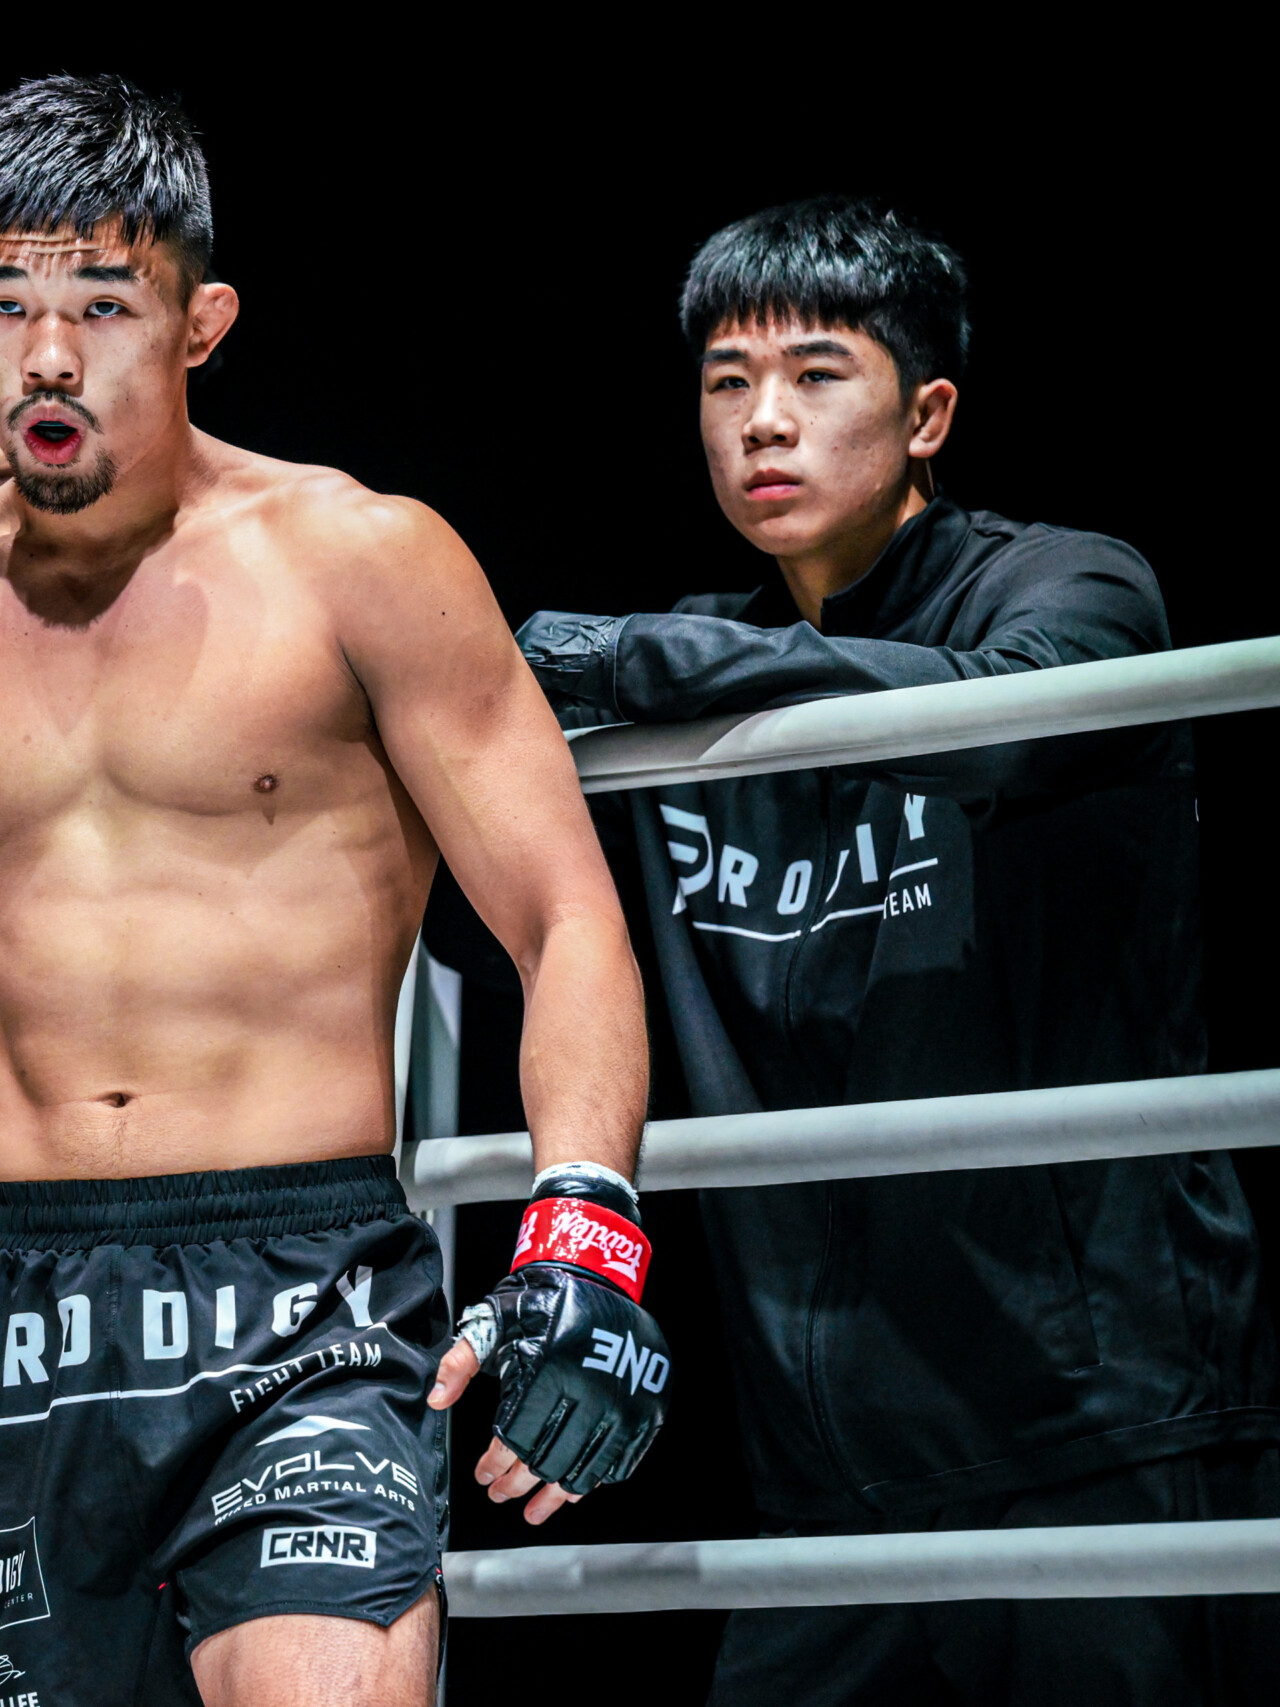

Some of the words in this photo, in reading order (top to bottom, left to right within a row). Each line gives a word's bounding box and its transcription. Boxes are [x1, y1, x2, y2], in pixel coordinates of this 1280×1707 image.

[581, 1327, 670, 1396] ONE
[211, 1450, 419, 1516] EVOLVE
[274, 1480, 367, 1502] MARTIAL
[374, 1484, 416, 1512] ARTS
